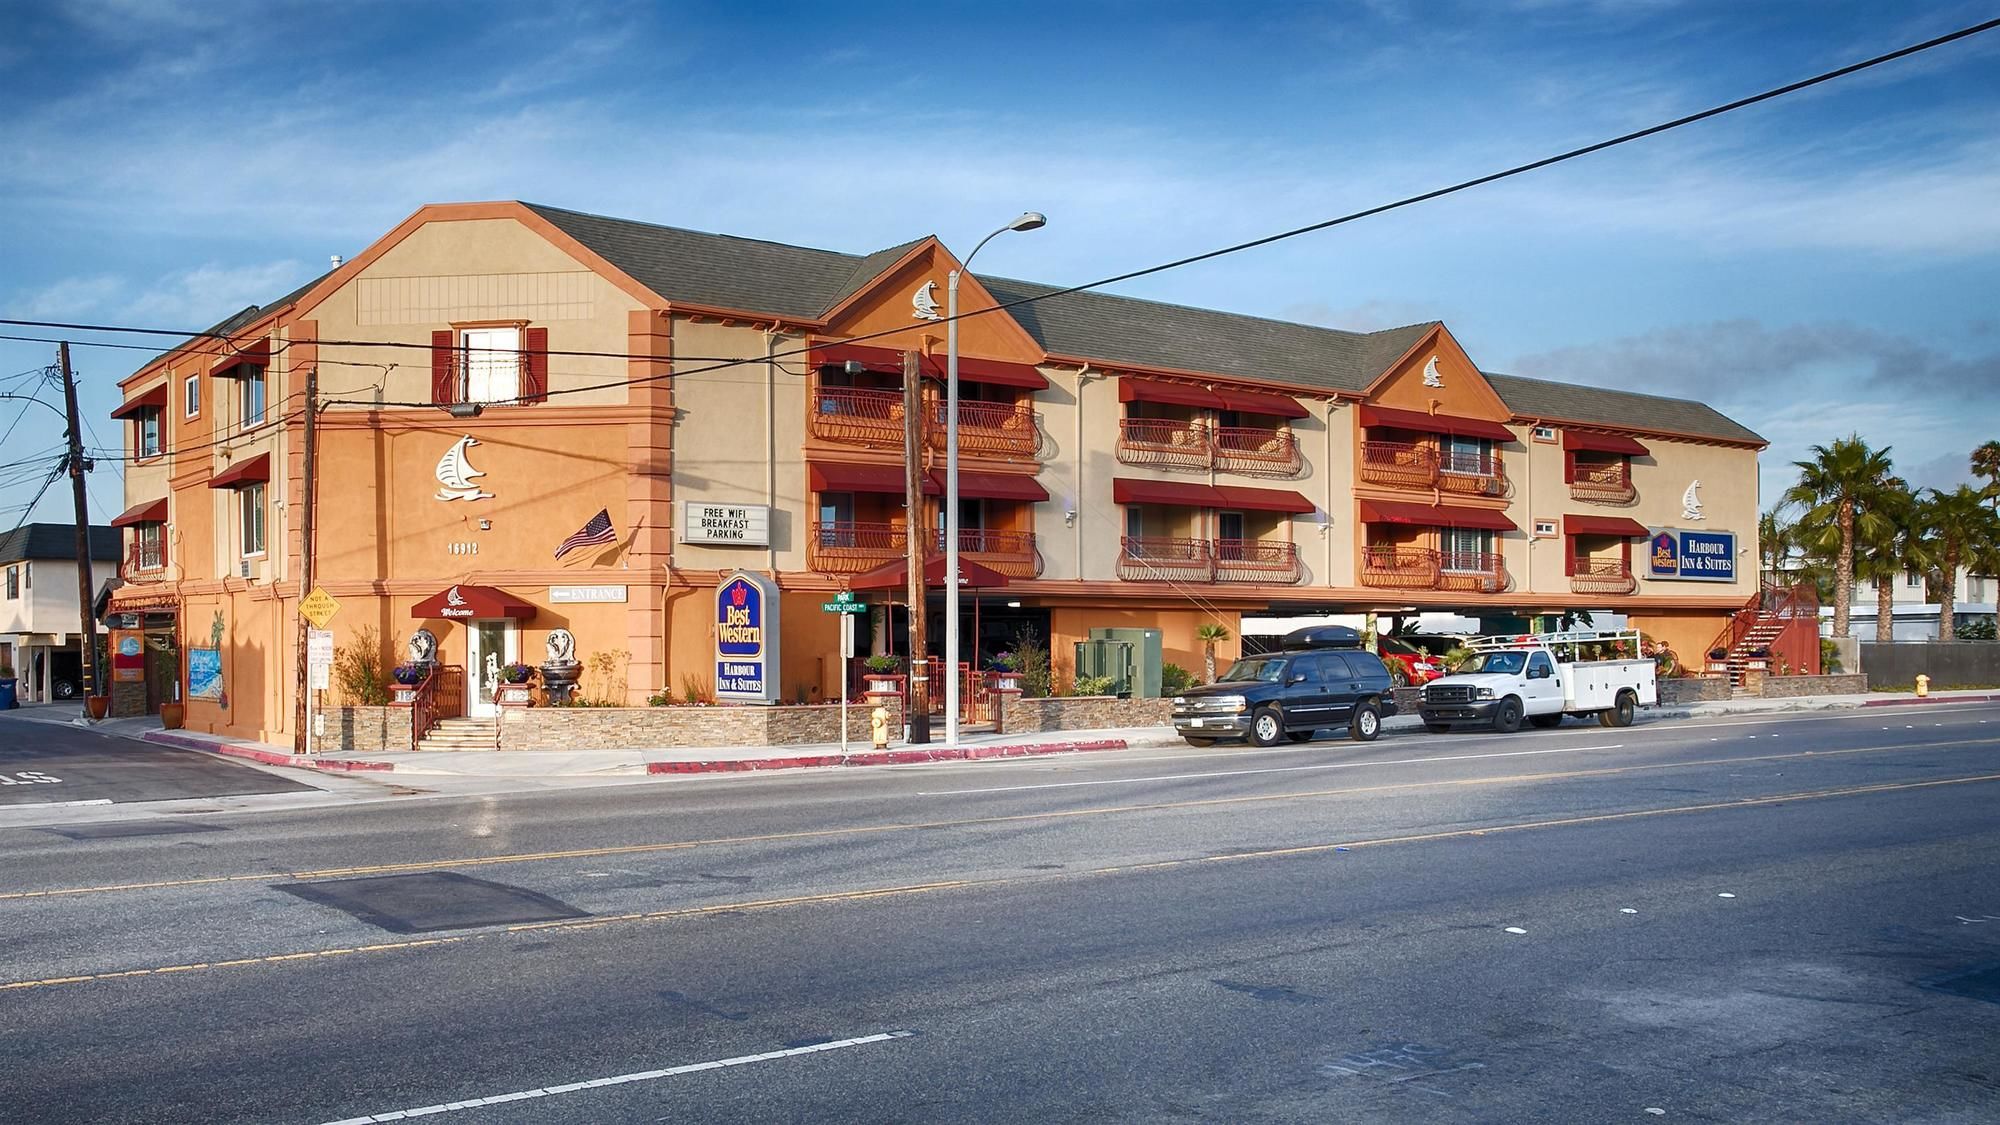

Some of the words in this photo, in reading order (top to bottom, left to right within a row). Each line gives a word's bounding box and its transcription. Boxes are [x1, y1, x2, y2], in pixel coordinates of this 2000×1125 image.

[704, 508, 724, 518] FREE
[728, 509, 746, 519] WIFI
[701, 518, 749, 529] BREAKFAST
[707, 529, 744, 539] PARKING
[447, 542, 479, 555] 16912
[1657, 546, 1671, 558] Best
[1689, 539, 1724, 554] HARBOUR
[1652, 555, 1677, 568] Western
[1681, 555, 1695, 569] INN
[1696, 556, 1703, 570] &
[1704, 556, 1732, 571] SUITES
[571, 586, 624, 600] ENTRANCE
[440, 608, 473, 617] Welcome
[726, 605, 751, 626] Best
[719, 623, 760, 643] Western
[724, 663, 755, 676] HARBOUR
[731, 678, 738, 691] &
